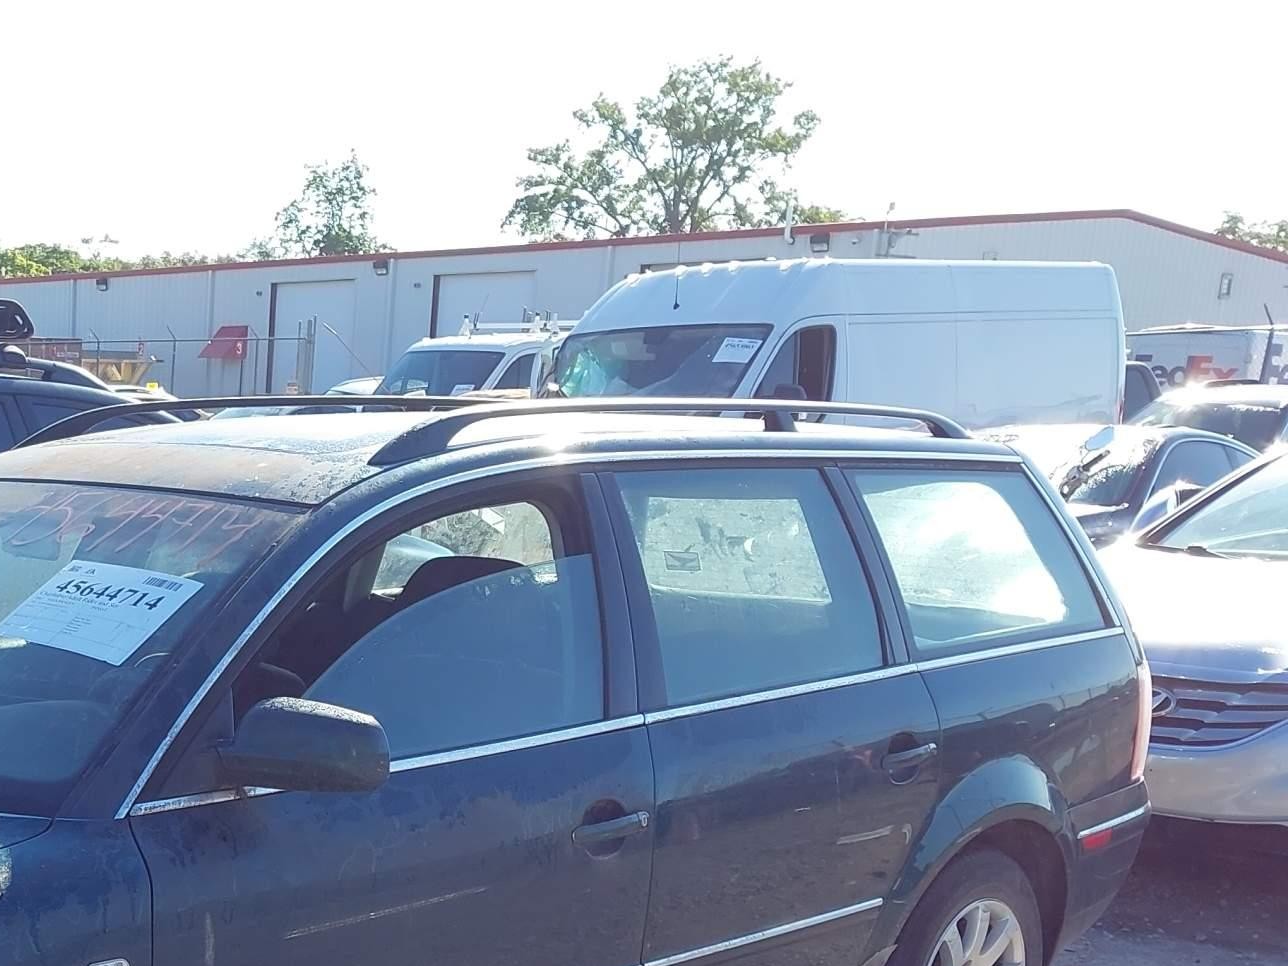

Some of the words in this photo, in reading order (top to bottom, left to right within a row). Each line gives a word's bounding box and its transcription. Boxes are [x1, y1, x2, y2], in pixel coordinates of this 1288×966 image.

[236, 342, 242, 354] 3
[1136, 354, 1239, 386] edEx
[56, 578, 165, 611] 45644714
